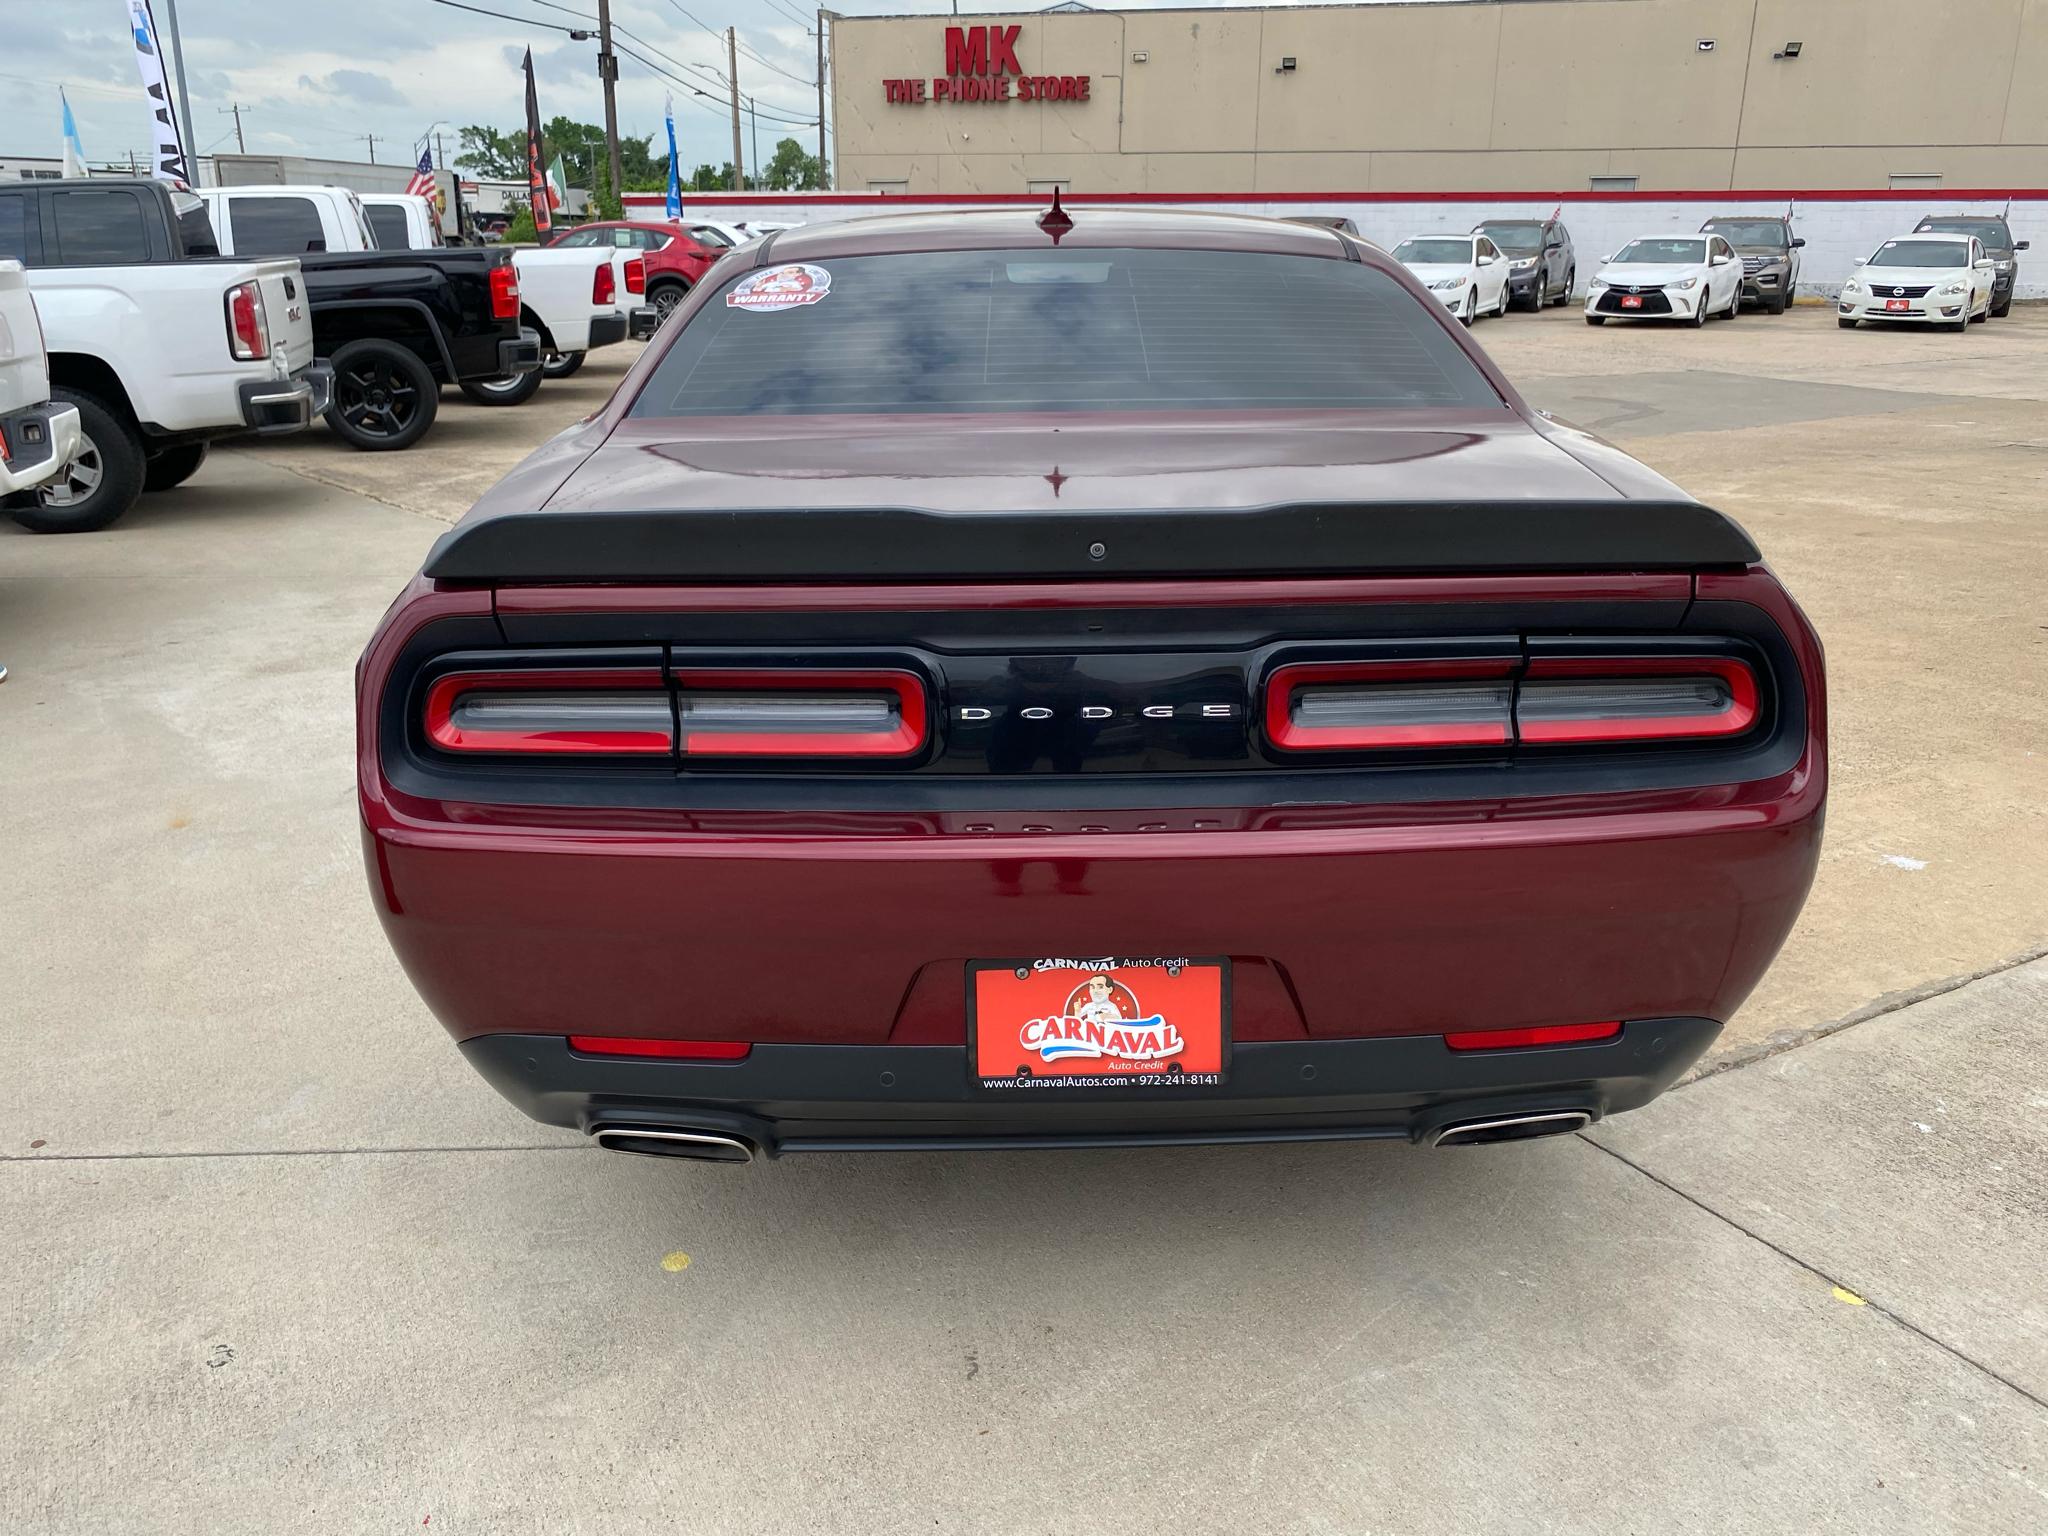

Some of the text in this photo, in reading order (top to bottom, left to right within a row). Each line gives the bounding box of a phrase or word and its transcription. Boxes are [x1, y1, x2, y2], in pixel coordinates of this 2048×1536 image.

[945, 25, 1022, 77] MK
[882, 76, 1090, 103] THE PHONE STORE
[734, 293, 816, 304] WARRANTY
[961, 704, 1231, 720] DODGE
[1033, 957, 1189, 972] CARNAVAL Auto Credit
[1020, 1016, 1184, 1059] CARNAVAL
[1108, 1060, 1164, 1070] Auto Credit
[983, 1075, 1219, 1089] www.CarnavalAutos.com 972-241-8141
